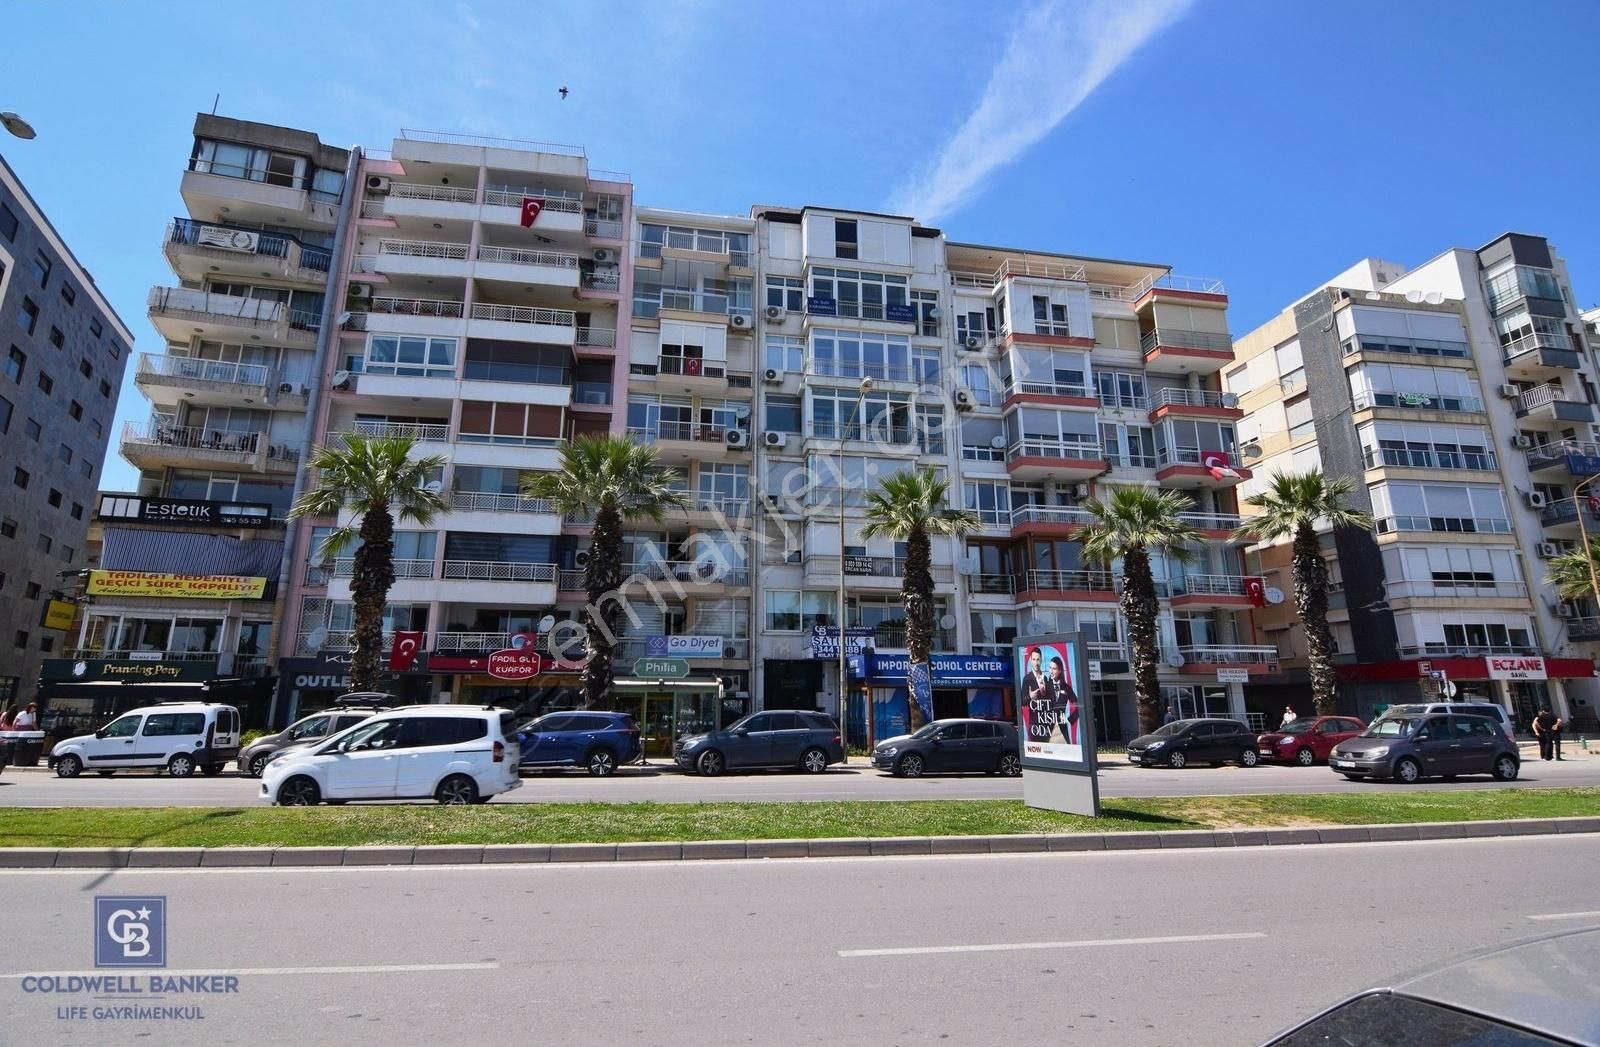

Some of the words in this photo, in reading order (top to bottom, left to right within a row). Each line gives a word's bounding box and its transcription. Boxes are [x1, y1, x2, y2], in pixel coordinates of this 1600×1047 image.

[146, 580, 184, 589] SÜRE
[188, 582, 260, 591] KAPALIYIZ
[670, 637, 687, 647] Go
[690, 637, 720, 652] Diyet
[813, 636, 859, 646] SATIIK
[102, 664, 152, 677] Prancing
[154, 664, 182, 677] Pony
[495, 664, 532, 673] KUAFÖR
[645, 662, 677, 672] Philia
[877, 661, 909, 670] IMPOR
[930, 661, 962, 671] COHOL
[965, 661, 1002, 671] CENTER
[1492, 659, 1542, 671] ECZANE
[295, 675, 352, 687] OUTLE
[1030, 724, 1053, 737] ODA
